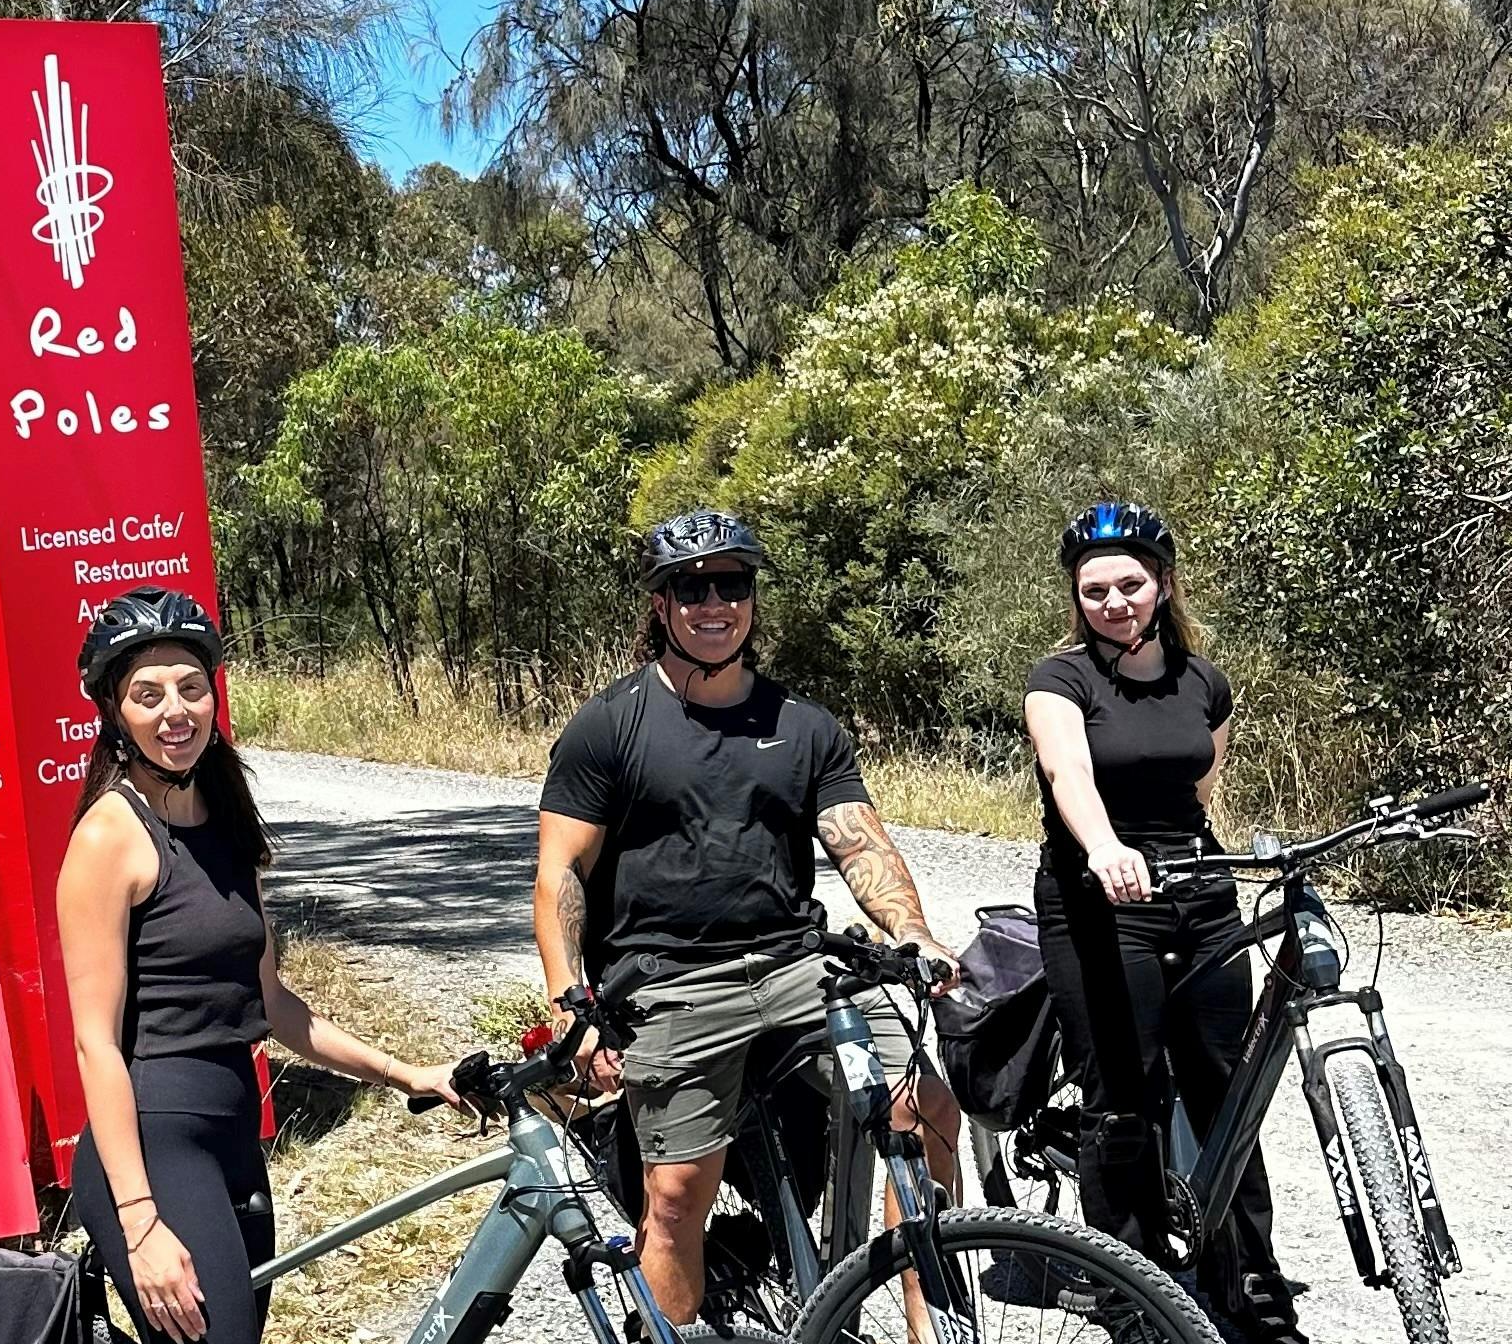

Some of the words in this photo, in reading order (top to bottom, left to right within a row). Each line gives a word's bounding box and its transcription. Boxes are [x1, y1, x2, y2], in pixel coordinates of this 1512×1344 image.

[29, 306, 138, 358] Red
[9, 389, 171, 440] Poles
[20, 518, 115, 552] Licensed
[121, 511, 185, 542] Cafe/
[74, 552, 191, 585] Restaurant
[38, 753, 90, 784] Craf
